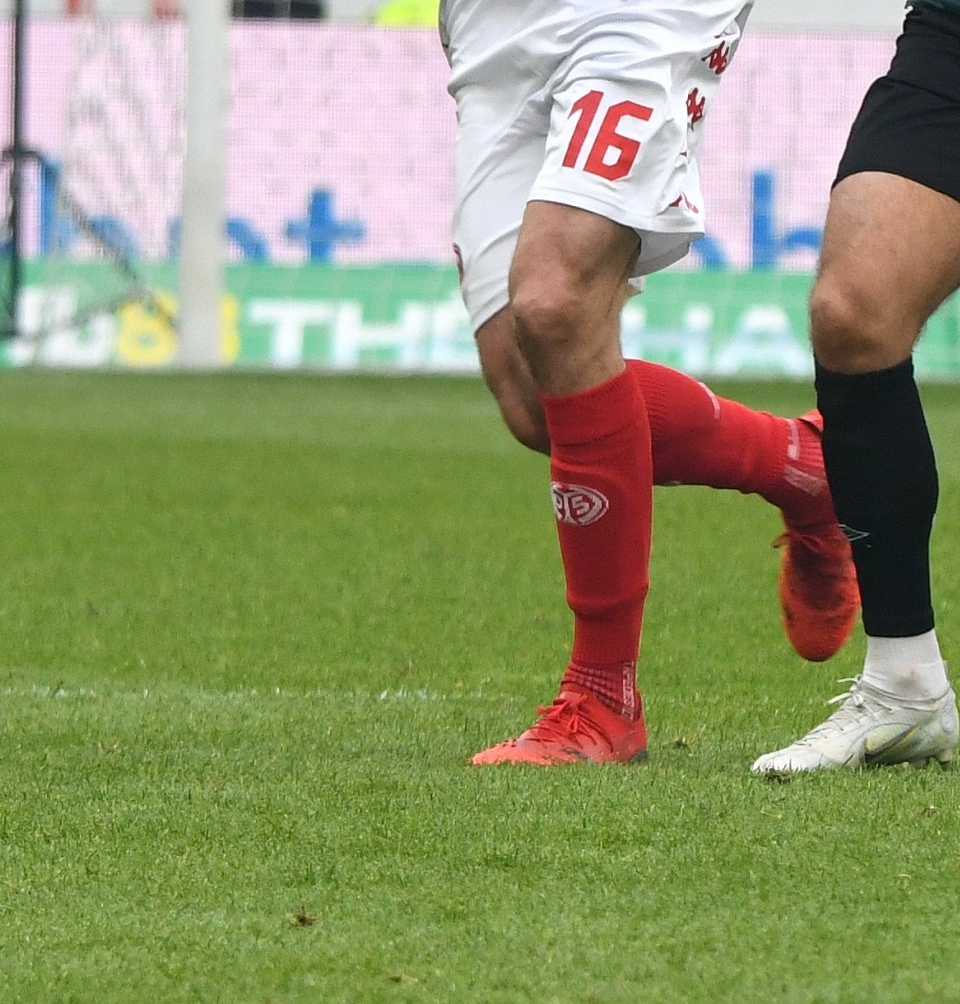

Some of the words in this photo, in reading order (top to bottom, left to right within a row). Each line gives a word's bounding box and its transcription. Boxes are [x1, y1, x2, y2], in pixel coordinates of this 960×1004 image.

[561, 89, 655, 182] 16
[6, 288, 240, 366] fb8
[621, 304, 816, 374] HA
